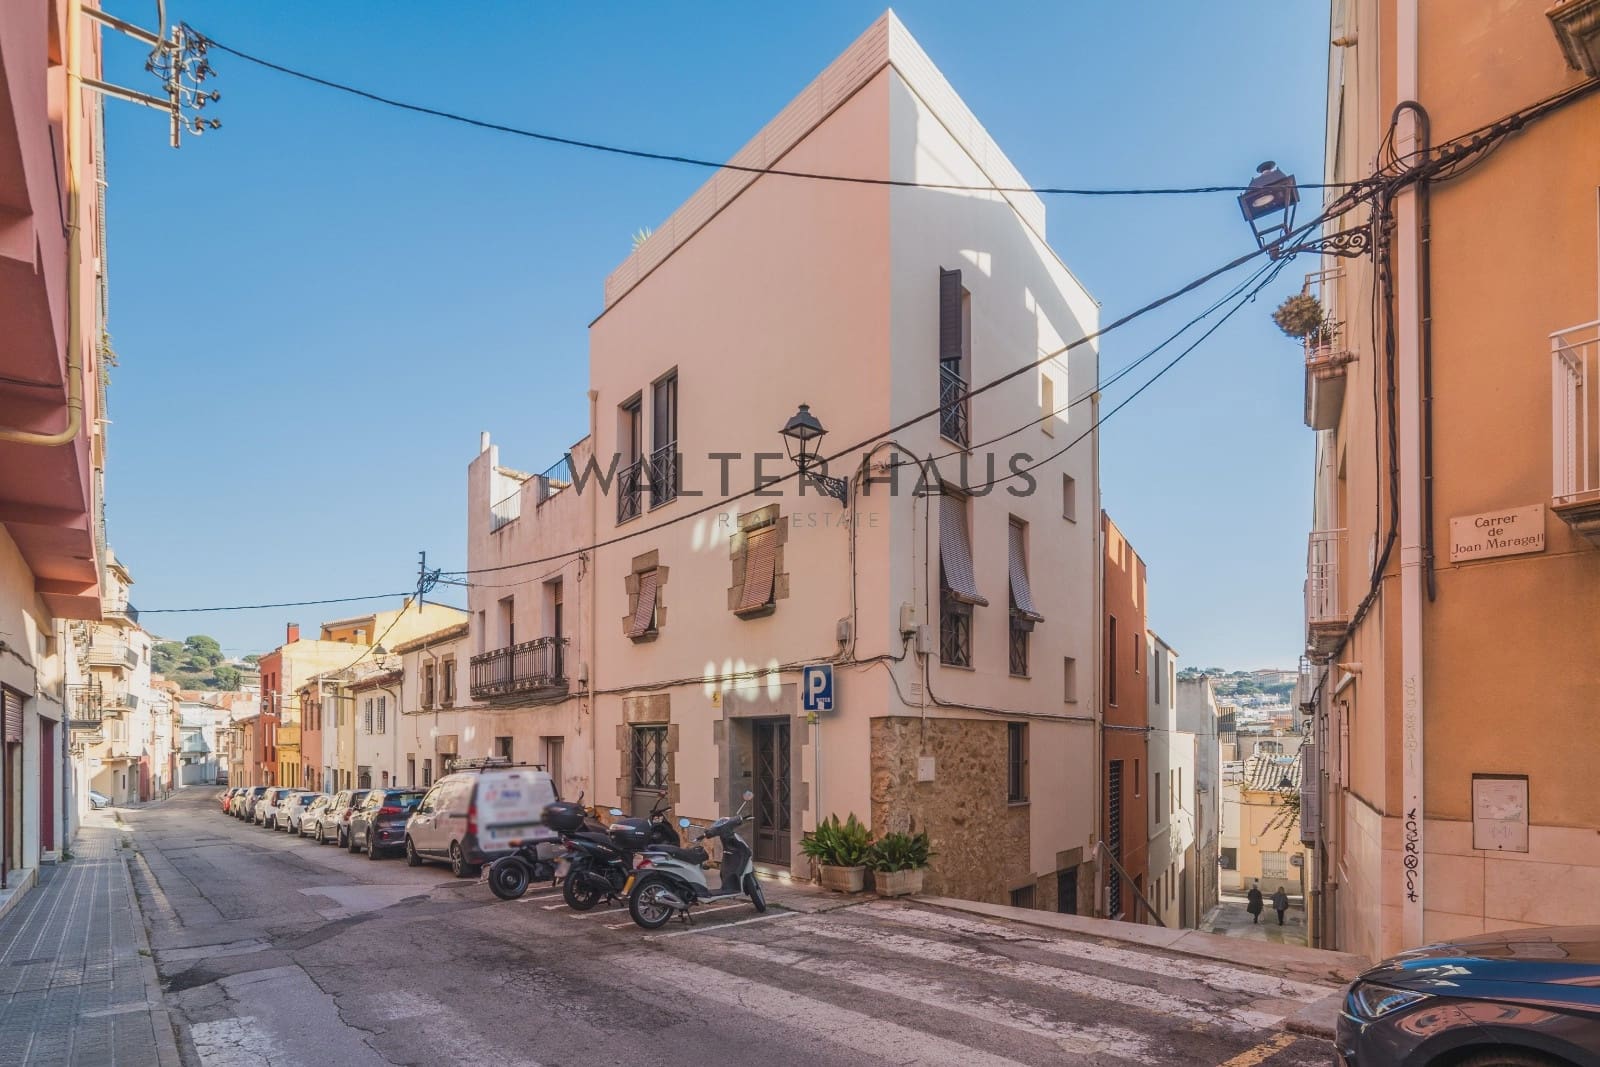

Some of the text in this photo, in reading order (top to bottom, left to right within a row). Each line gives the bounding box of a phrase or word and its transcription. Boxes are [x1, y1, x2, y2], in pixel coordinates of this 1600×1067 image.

[1475, 515, 1518, 528] Carrer
[1488, 528, 1503, 537] de
[1452, 533, 1544, 555] Joan Maragall
[809, 670, 826, 705] P
